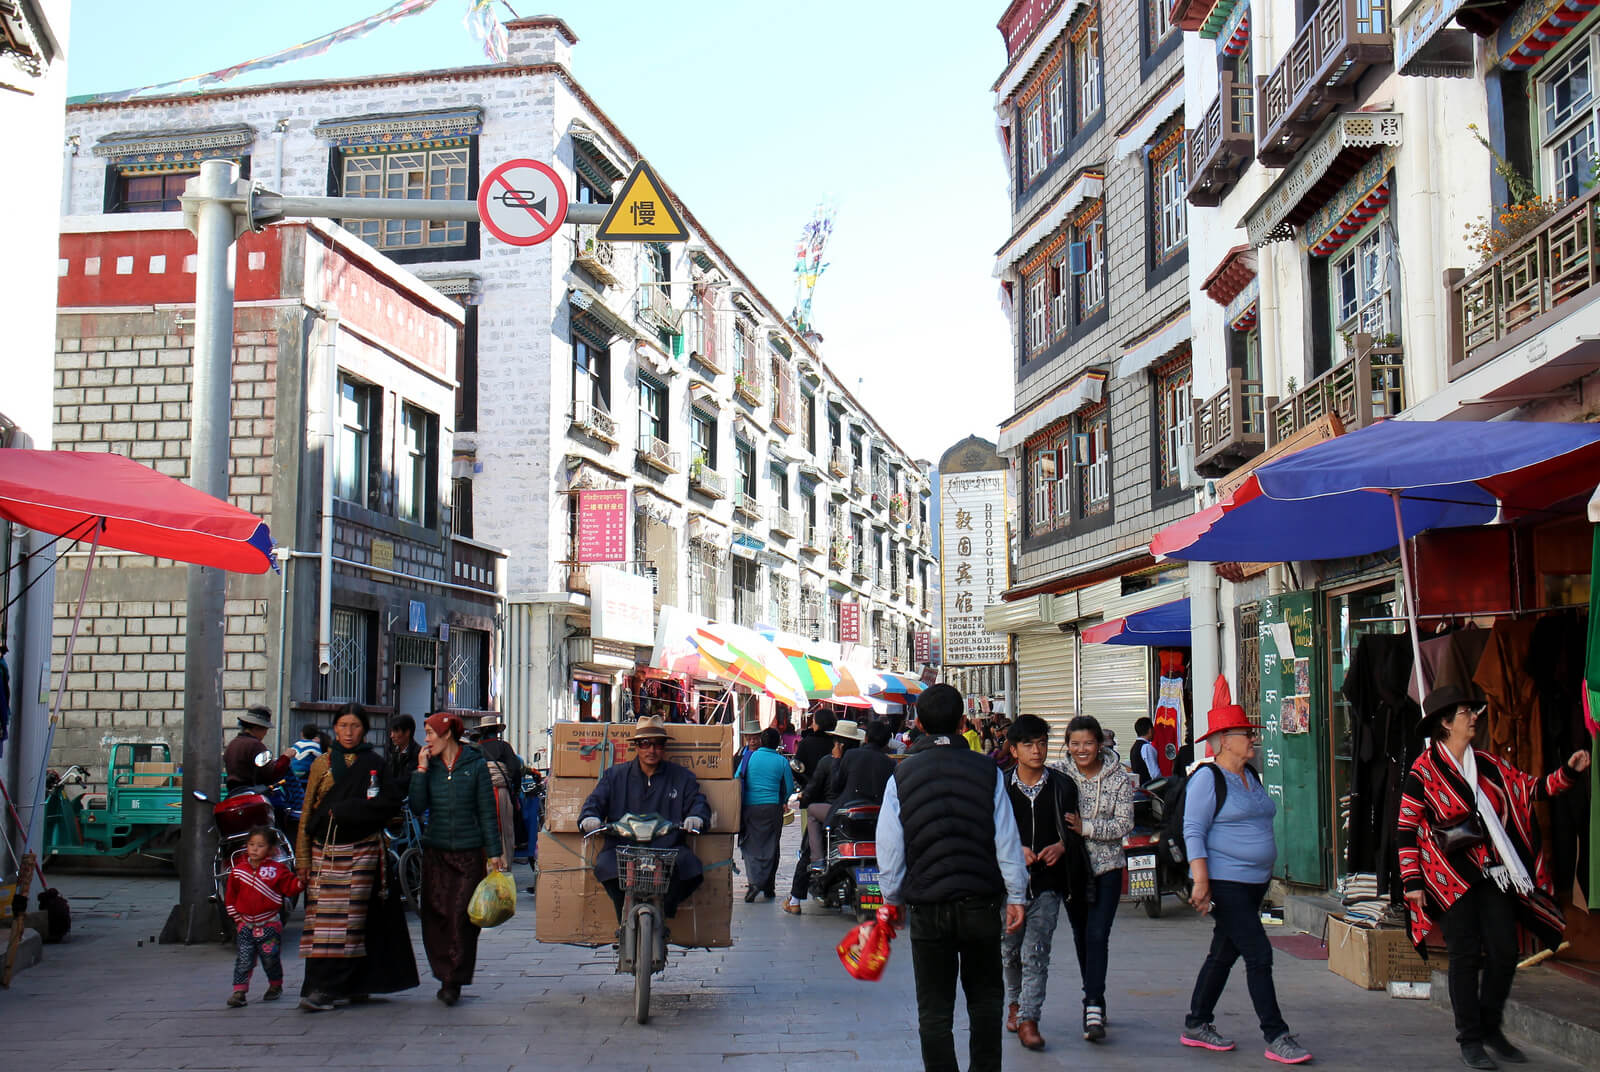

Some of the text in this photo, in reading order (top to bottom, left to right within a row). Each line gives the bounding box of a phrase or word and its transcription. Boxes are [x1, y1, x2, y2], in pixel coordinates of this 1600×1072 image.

[630, 201, 656, 226] 慢
[986, 568, 995, 604] HOTE
[258, 866, 277, 879] 55
